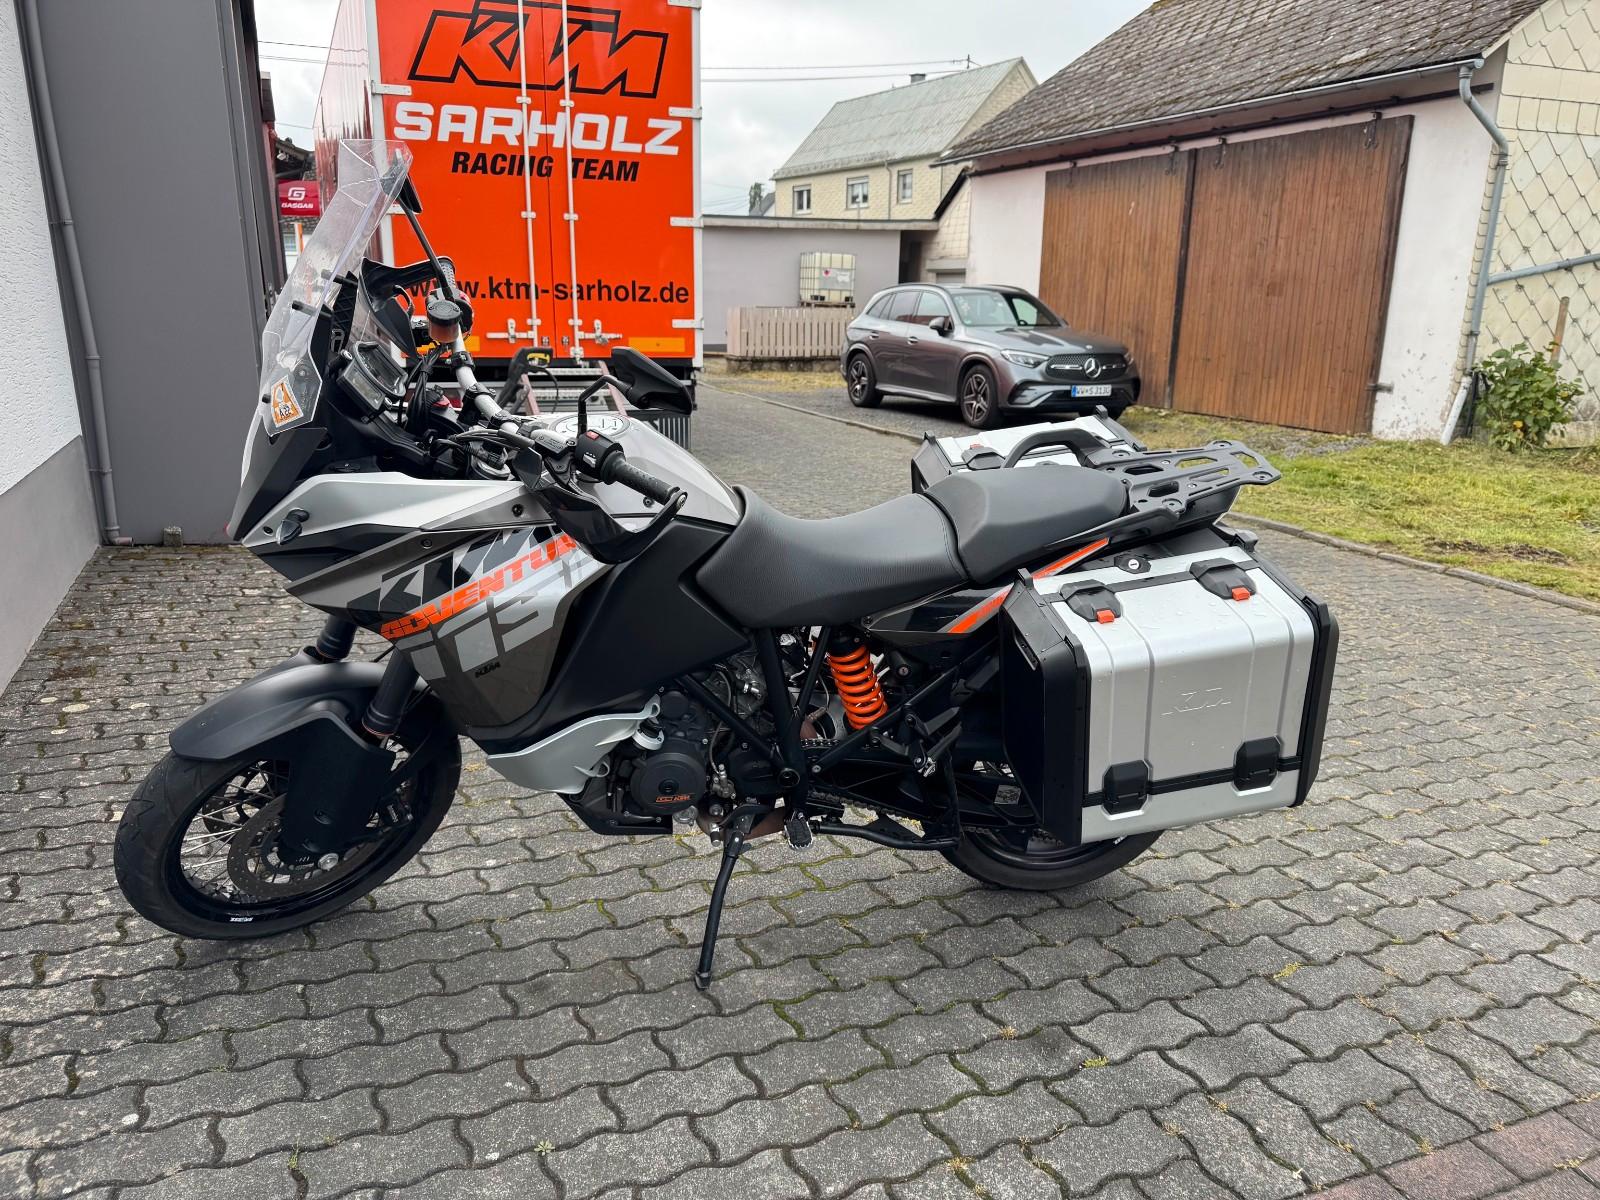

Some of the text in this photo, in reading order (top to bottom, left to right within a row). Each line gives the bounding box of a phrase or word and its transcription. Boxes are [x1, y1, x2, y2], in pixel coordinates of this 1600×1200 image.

[407, 0, 669, 99] KTM
[393, 101, 683, 156] SARHOLZ
[451, 151, 640, 182] RACING TEAM
[379, 534, 578, 640] ADVENTUR
